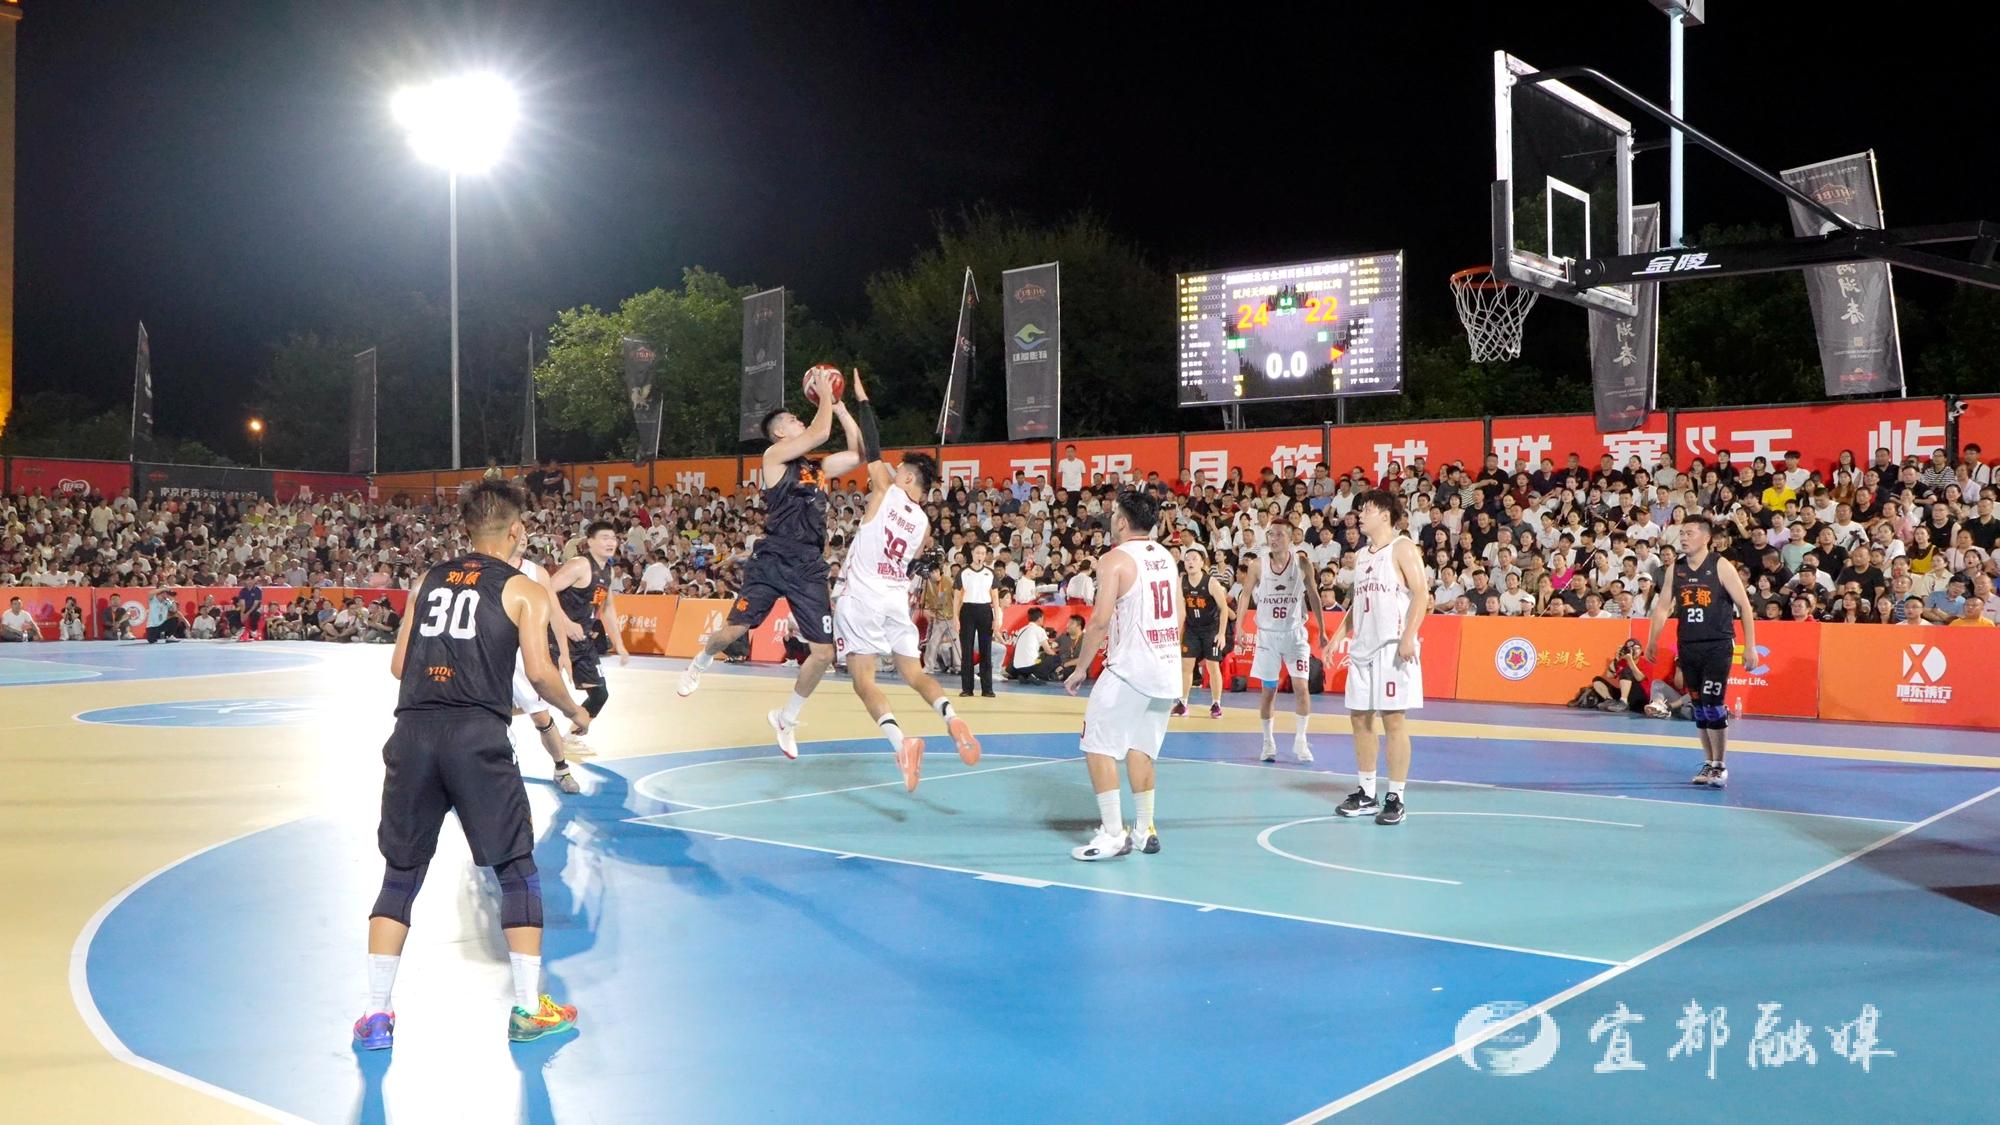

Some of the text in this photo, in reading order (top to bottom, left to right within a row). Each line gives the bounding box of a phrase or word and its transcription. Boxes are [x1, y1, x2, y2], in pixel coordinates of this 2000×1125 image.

[1644, 252, 1709, 273] 金陵
[1236, 303, 1269, 330] 24
[1304, 296, 1338, 324] 22
[1265, 351, 1308, 379] 0.0
[1234, 385, 1243, 397] 3
[1150, 580, 1173, 620] 10
[1681, 588, 1712, 607] 宜都
[420, 587, 481, 640] 30
[1193, 609, 1201, 618] 11
[1273, 607, 1287, 619] 66
[1687, 608, 1704, 623] 23
[822, 615, 832, 634] 8
[1212, 646, 1219, 657] 11
[1385, 681, 1395, 697] 0
[1703, 680, 1722, 696] 23
[1749, 677, 1769, 686] Life.
